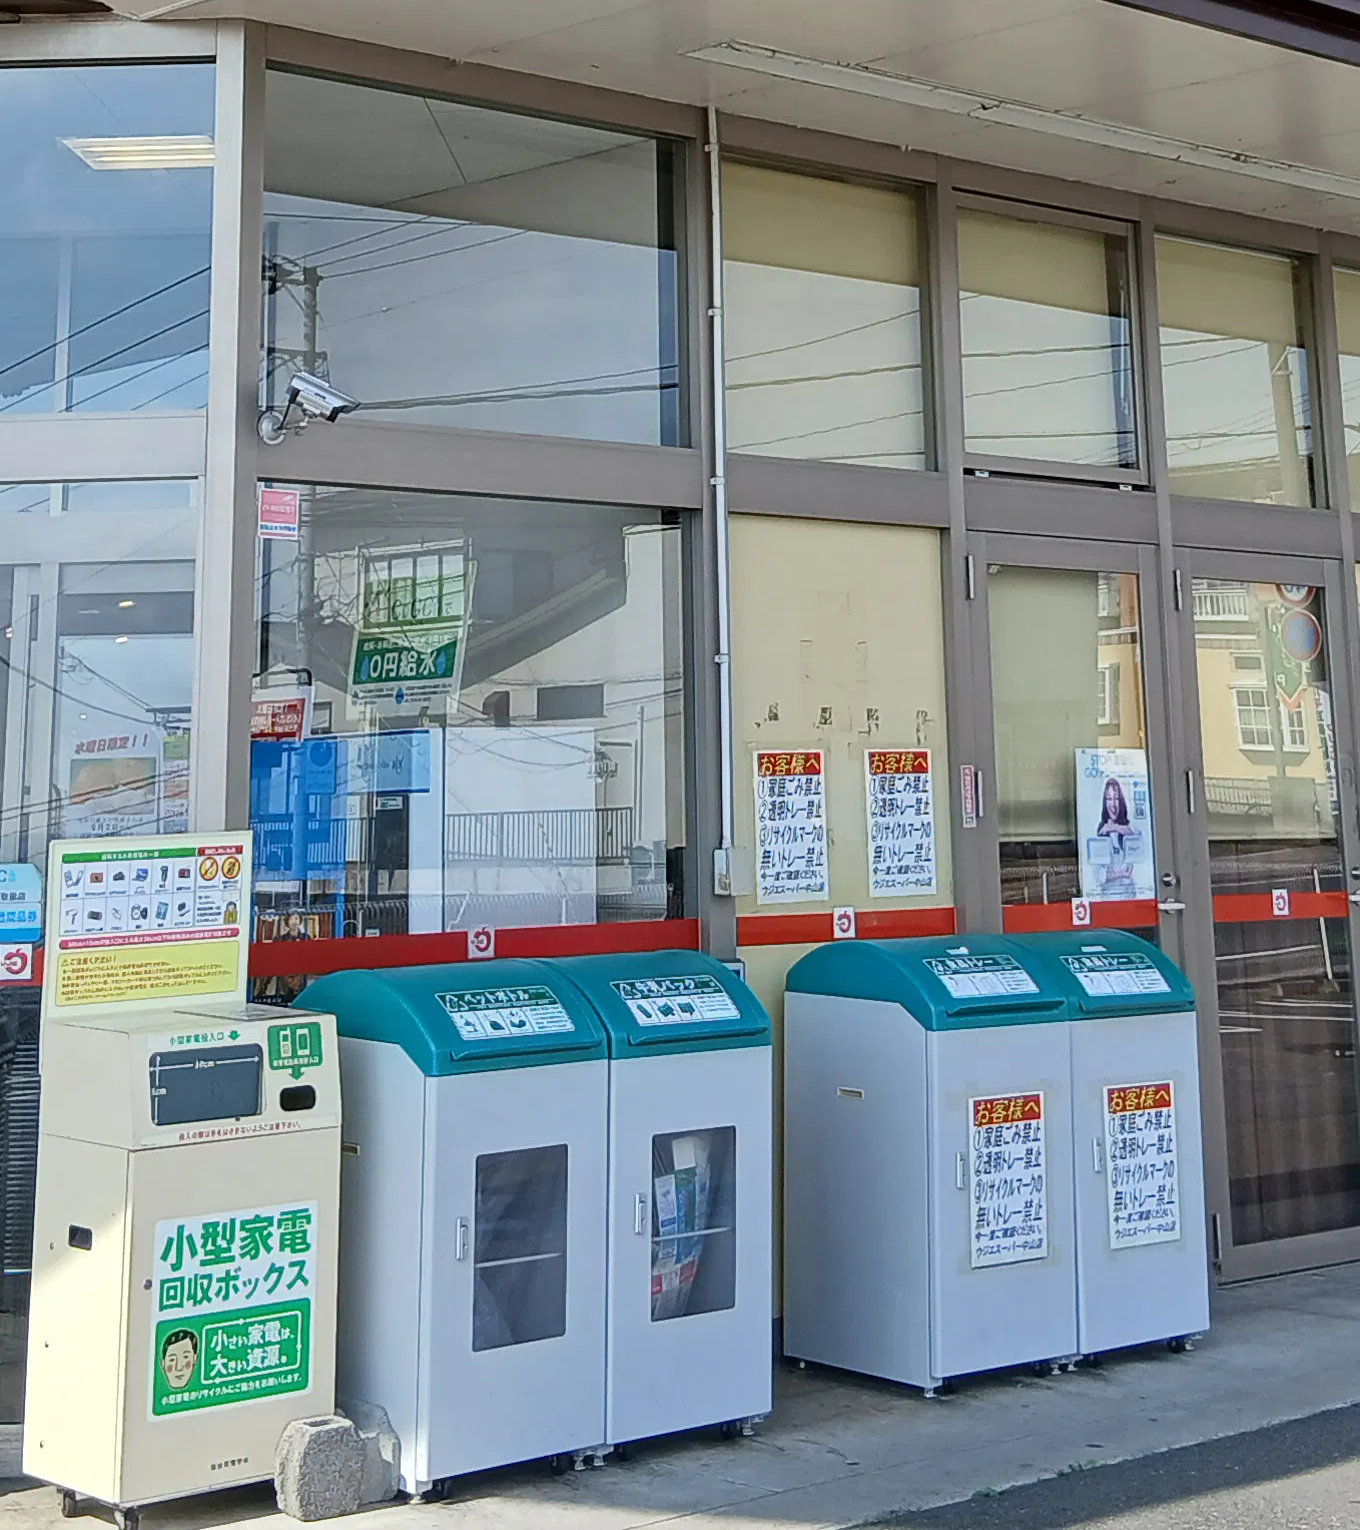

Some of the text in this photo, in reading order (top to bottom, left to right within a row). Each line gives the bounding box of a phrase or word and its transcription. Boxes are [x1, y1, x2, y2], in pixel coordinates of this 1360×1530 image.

[369, 650, 437, 680] 0円給水
[760, 753, 820, 775] お客様へ
[870, 753, 928, 774] お客様へ
[975, 1098, 1040, 1125] お客様へ
[1109, 1086, 1170, 1112] お客様へ
[159, 1208, 313, 1272] 小型家電
[158, 1259, 310, 1312] 回収ボックス
[209, 1344, 289, 1378] 大きい資源。
